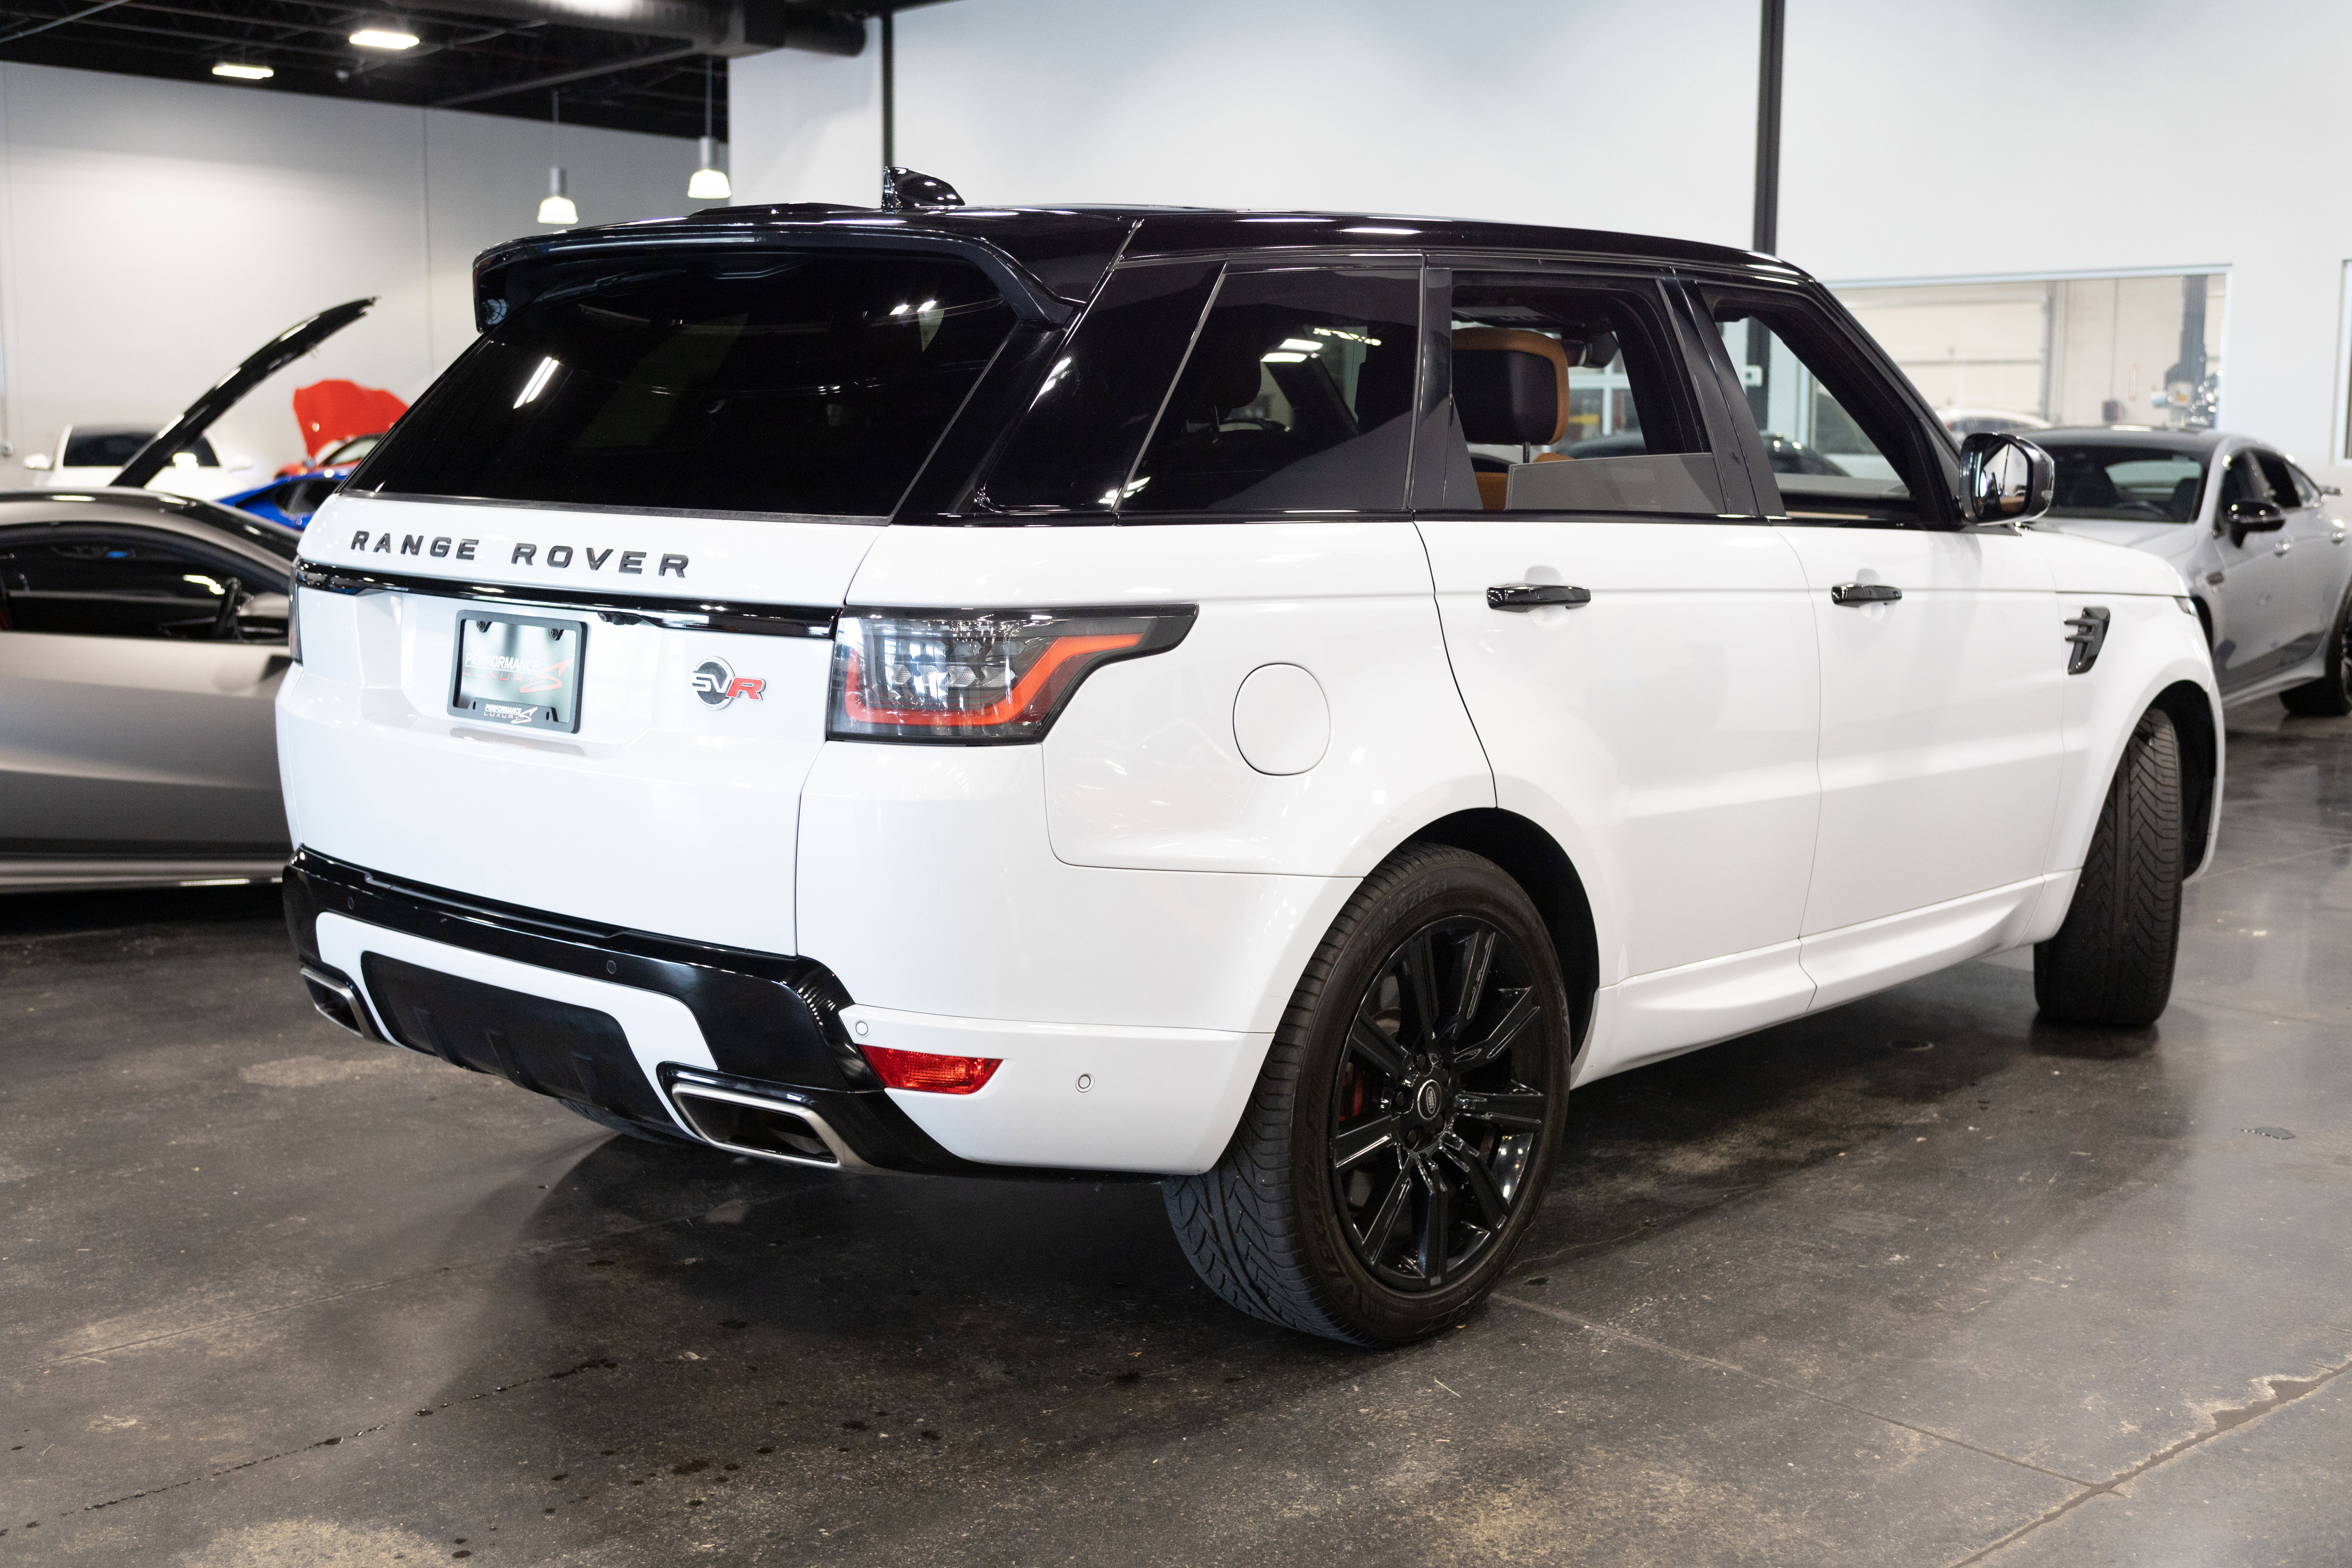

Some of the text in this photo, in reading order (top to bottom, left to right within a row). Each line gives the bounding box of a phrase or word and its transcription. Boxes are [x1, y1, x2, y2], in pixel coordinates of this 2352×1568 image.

[351, 530, 689, 578] RANGE ROVER
[465, 653, 540, 672] PERFORMANCE
[695, 657, 728, 670] SPECIAL VEHICLE
[691, 670, 766, 700] SVR
[485, 704, 522, 714] PERFORMANCE
[699, 699, 726, 709] OPERATIONS
